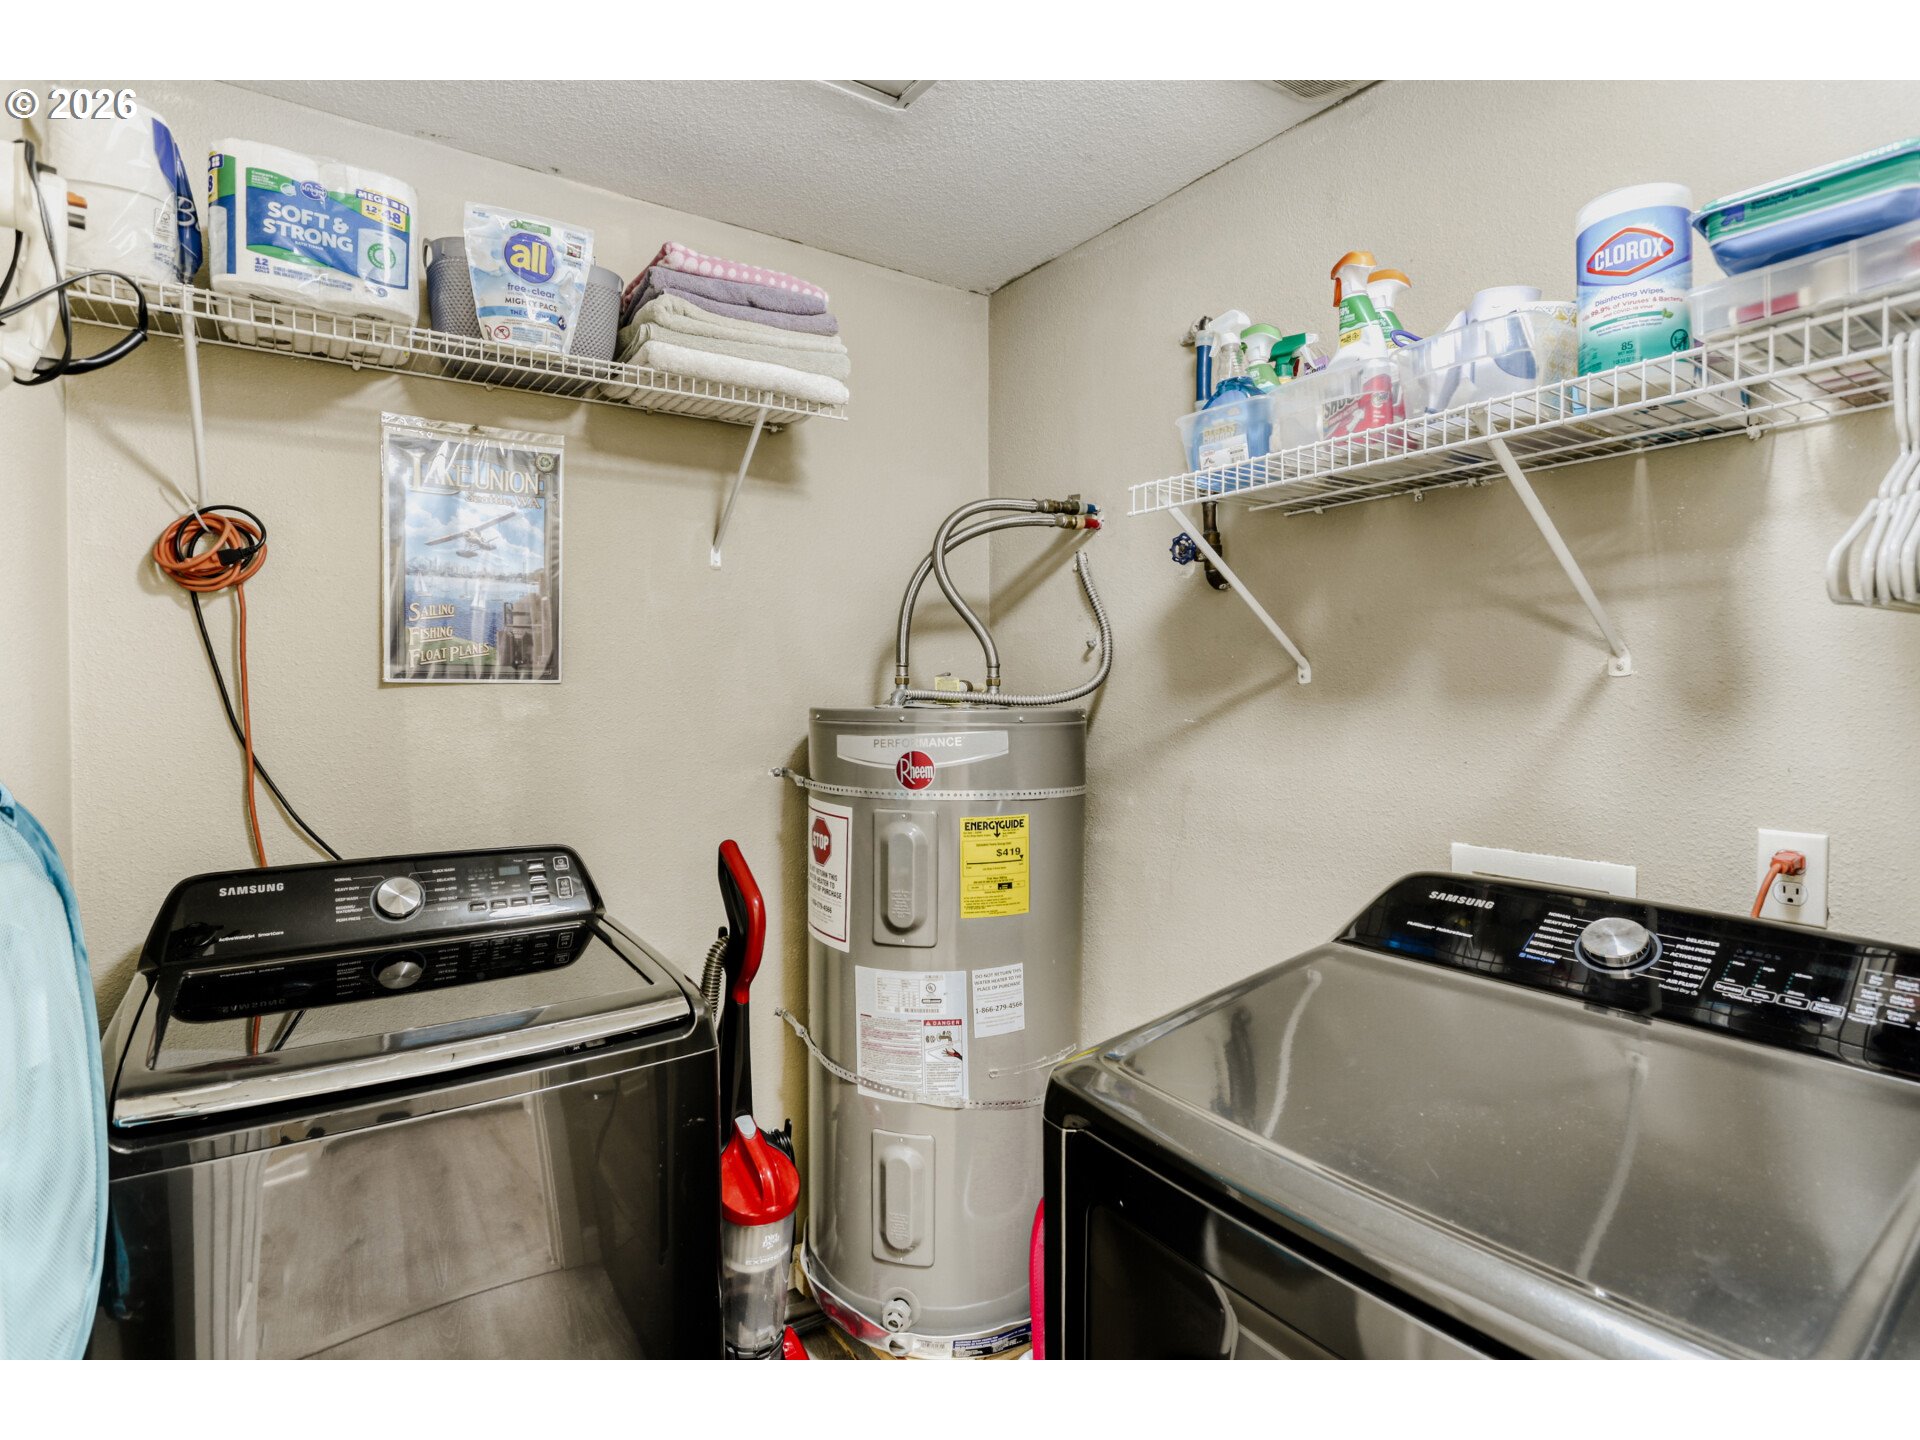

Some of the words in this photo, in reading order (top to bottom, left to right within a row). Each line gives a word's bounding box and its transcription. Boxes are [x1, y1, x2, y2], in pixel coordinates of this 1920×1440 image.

[357, 190, 389, 207] MEGA
[365, 204, 377, 214] 12
[267, 201, 329, 227] SOFT
[333, 217, 349, 234] &
[262, 218, 353, 253] STRONG
[510, 241, 547, 275] all
[1594, 236, 1665, 272] CLOROX
[255, 257, 269, 266] 12
[507, 282, 527, 293] free
[532, 288, 556, 299] clear
[1595, 291, 1638, 307] Disinfecting
[540, 302, 558, 313] PACS
[1591, 306, 1611, 318] 99.9%
[1613, 302, 1621, 310] of
[1622, 341, 1633, 351] 85
[407, 449, 470, 496] LAKE
[475, 462, 541, 496] UNION
[516, 495, 542, 510] WA
[408, 602, 455, 622] SAILING
[408, 625, 454, 646] FISHING
[408, 647, 447, 668] FLOAT
[449, 641, 490, 664] PLANES
[873, 735, 963, 748] PERFORMANCE
[899, 750, 934, 785] Rheem
[812, 830, 830, 851] STOP
[996, 847, 1021, 857] $419
[829, 872, 838, 882] THIS
[219, 882, 285, 897] SAMSUNG
[830, 881, 836, 889] TO
[822, 886, 842, 900] PURCHASE
[1429, 891, 1495, 910] SAMSUNG
[1548, 912, 1571, 920] NORMAL
[1539, 926, 1564, 935] BEDDING
[1530, 940, 1555, 949] REFRESH
[1686, 937, 1720, 948] DELICATES
[1670, 952, 1713, 964] ACTIVEWEAR
[1695, 948, 1716, 956] PRESS
[1673, 961, 1694, 969] QUICK
[1673, 970, 1689, 978] TIME
[999, 981, 1021, 989] PURCHASE
[1658, 984, 1680, 992] Manual
[1678, 981, 1700, 989] FLUFF
[1716, 984, 1742, 993] Dryness
[975, 1001, 1024, 1015] 1-866-279-4566
